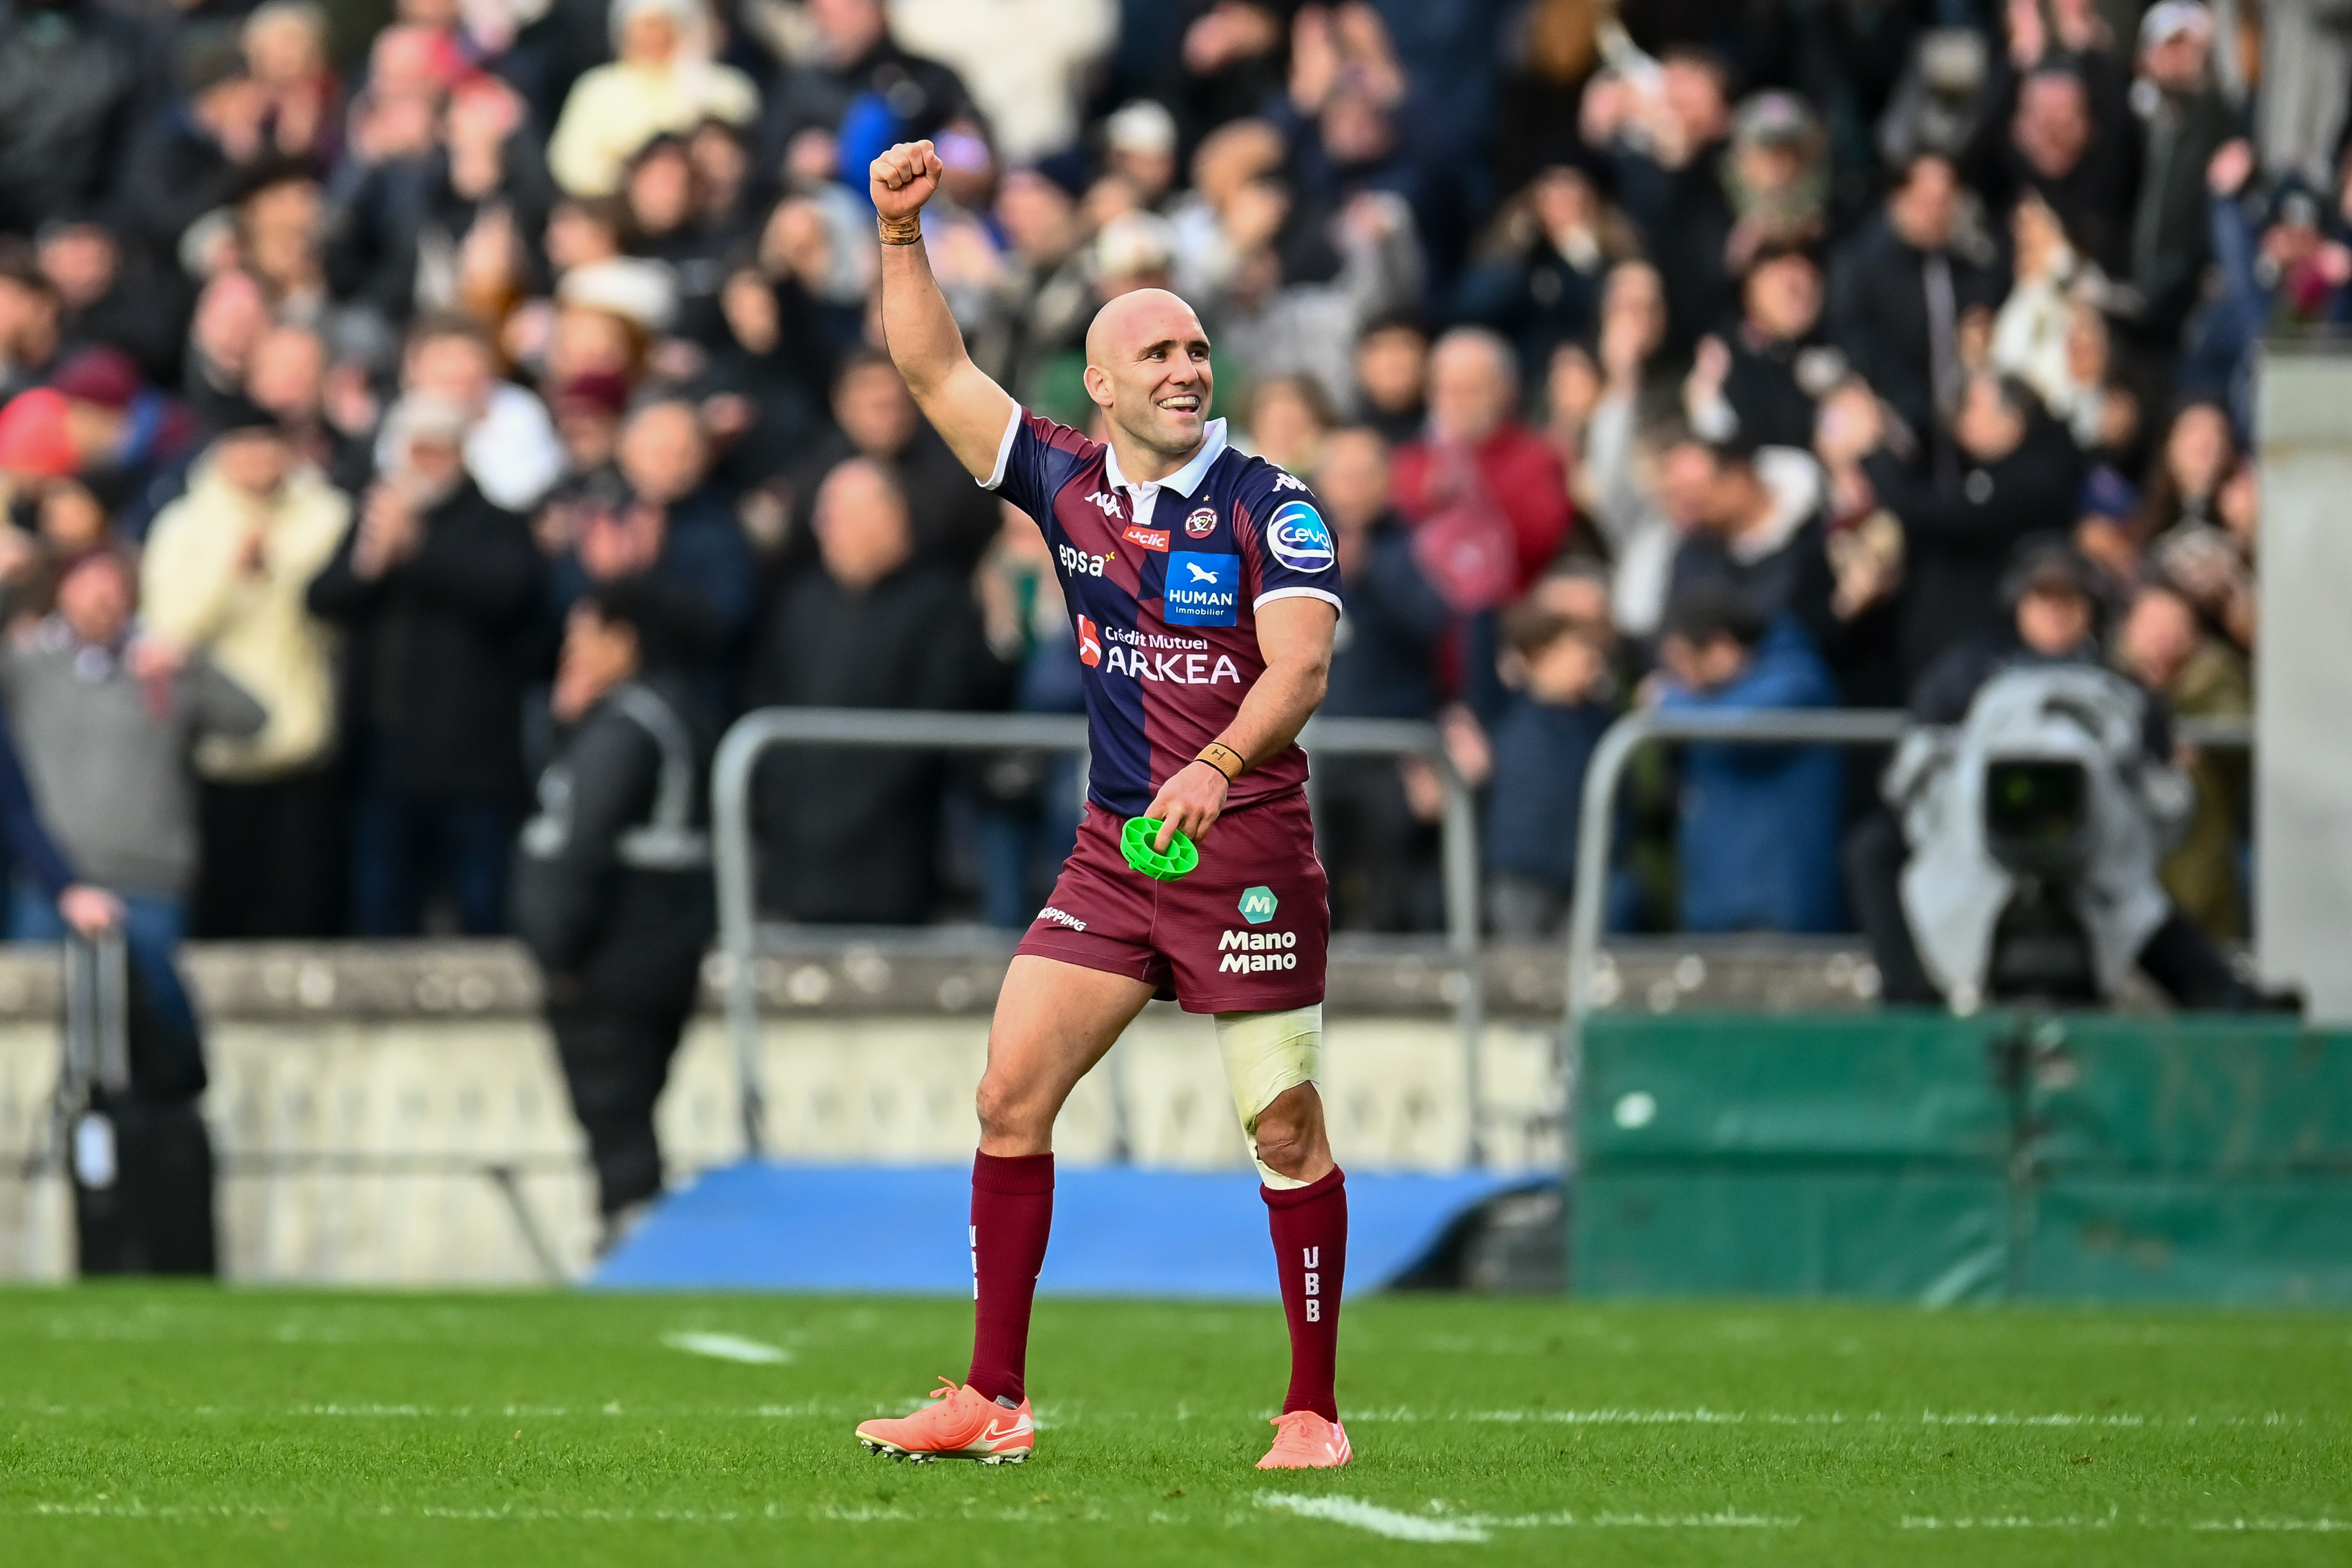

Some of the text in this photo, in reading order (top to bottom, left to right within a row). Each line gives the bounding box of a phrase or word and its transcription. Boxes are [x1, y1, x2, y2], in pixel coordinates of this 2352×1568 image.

[1059, 543, 1105, 577] epsa
[1169, 588, 1232, 606] HUMAN
[1176, 606, 1224, 616] Immobilier
[1105, 626, 1208, 650] Crédit Mutuel
[1106, 646, 1240, 685] ARKEA
[1244, 895, 1270, 914] M
[1218, 930, 1296, 951] Mano
[1218, 952, 1297, 975] Mano
[1303, 1246, 1320, 1322] UBB
